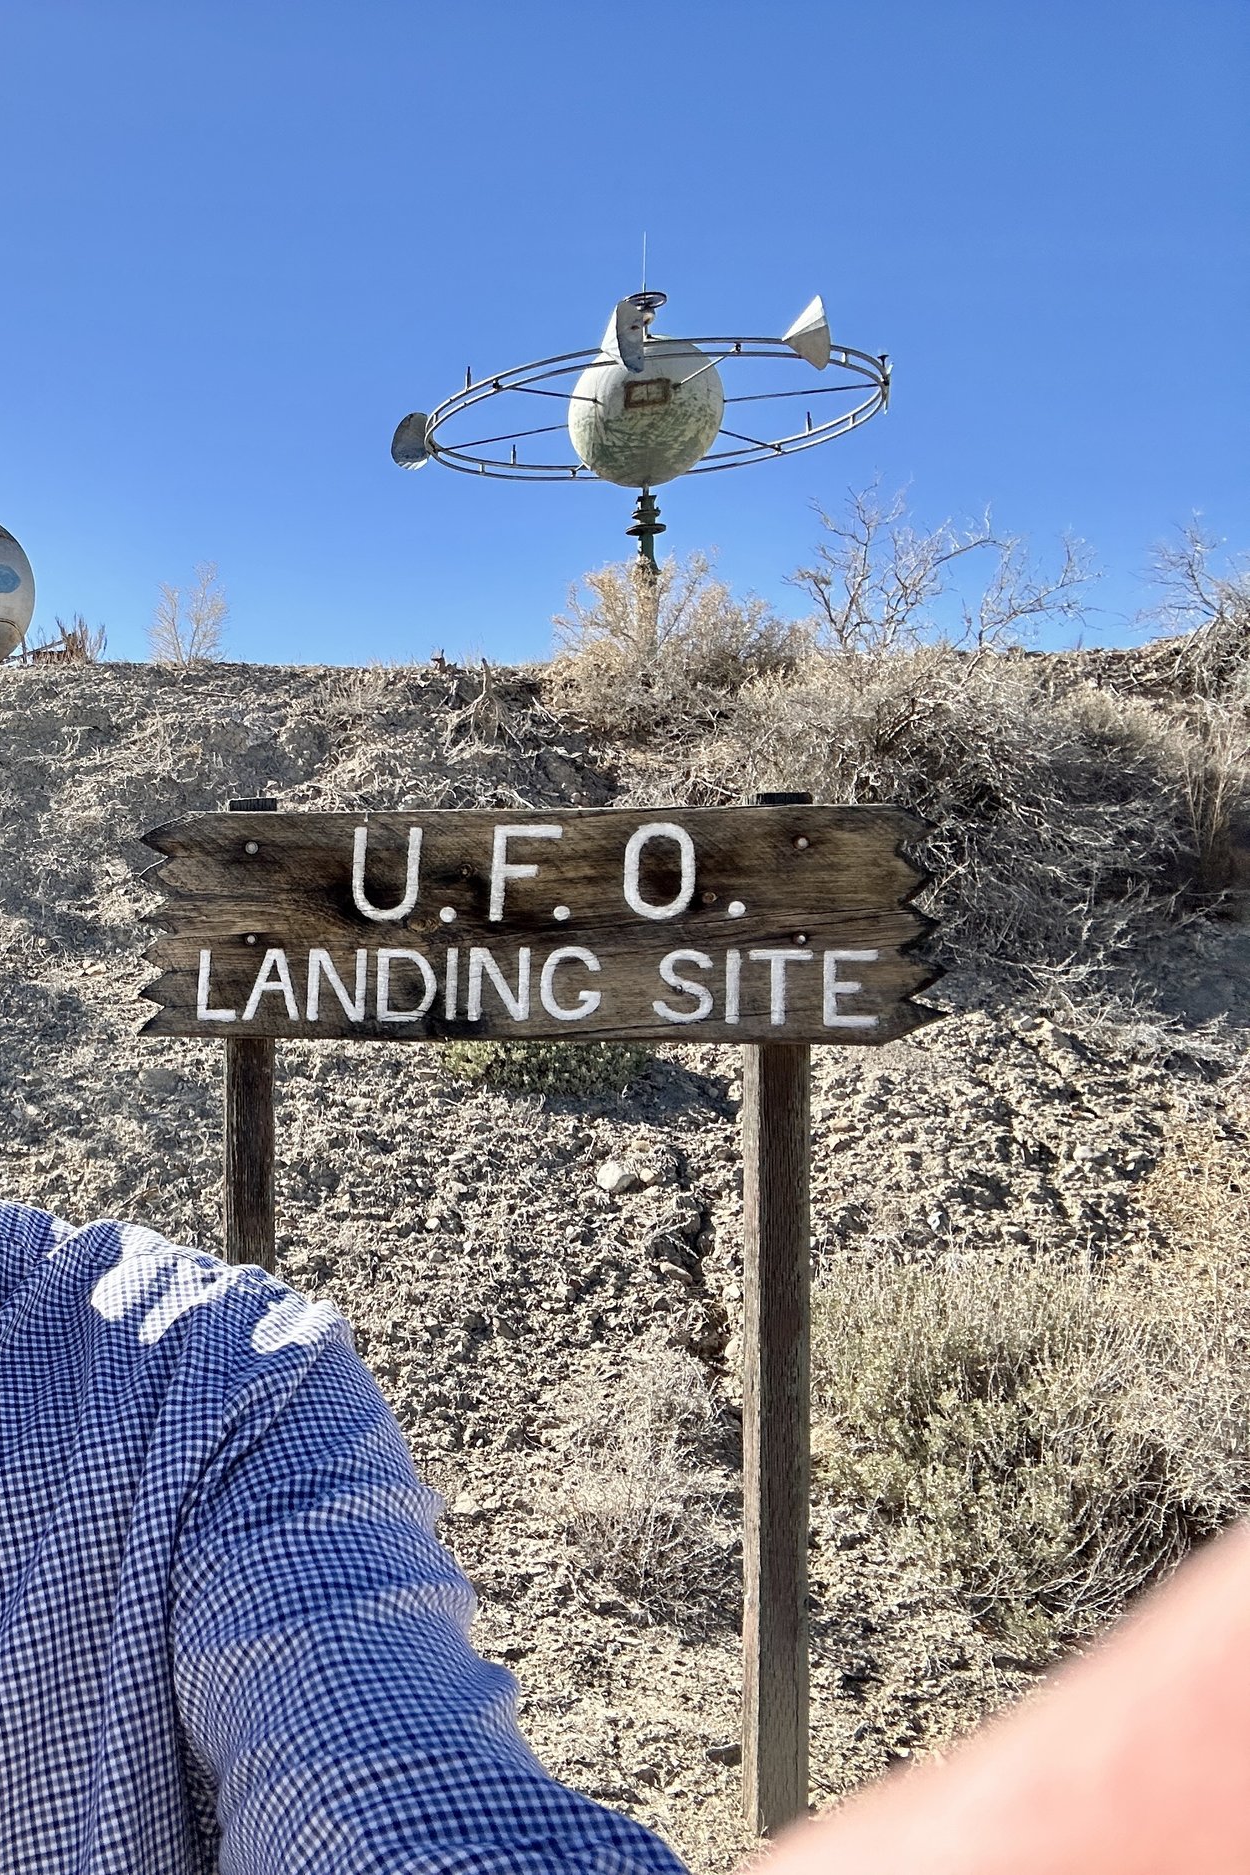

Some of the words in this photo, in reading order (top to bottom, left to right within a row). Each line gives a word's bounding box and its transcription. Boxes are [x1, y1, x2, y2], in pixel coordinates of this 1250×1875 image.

[352, 822, 746, 923] U.F.O.
[196, 946, 602, 1022] LANDING
[652, 948, 879, 1027] SITE
